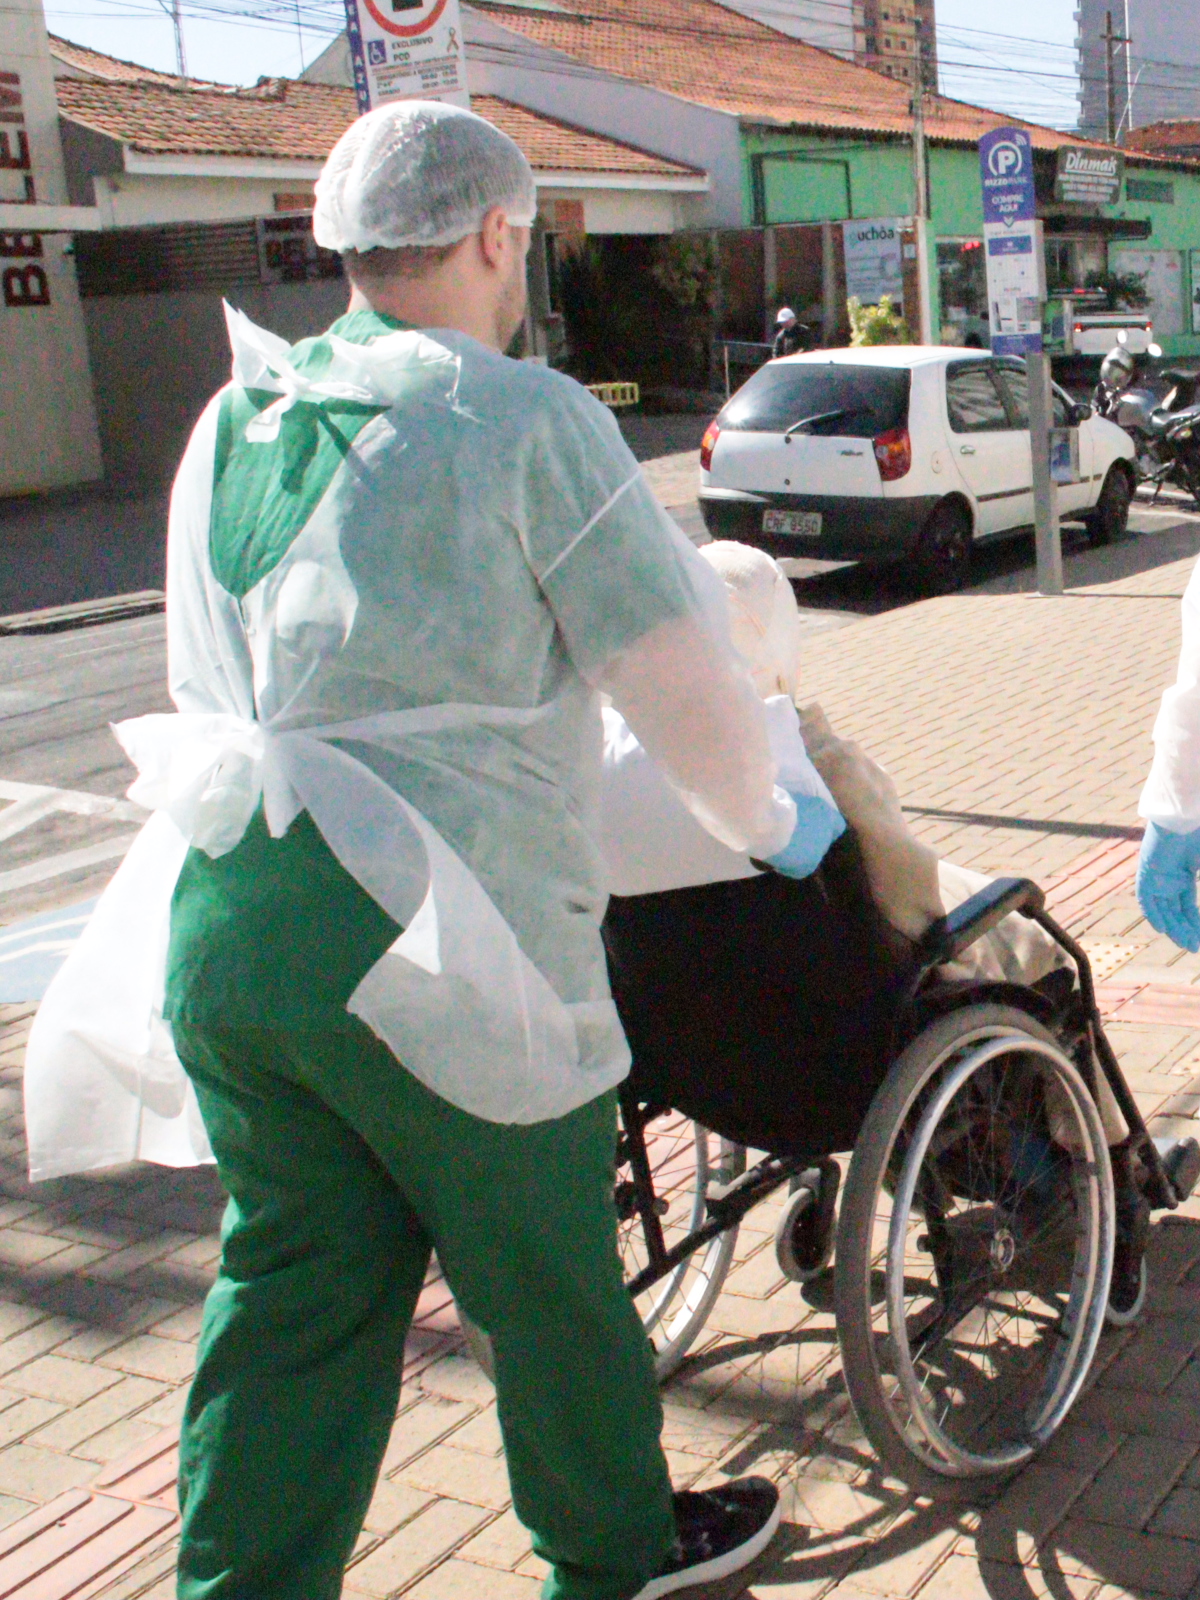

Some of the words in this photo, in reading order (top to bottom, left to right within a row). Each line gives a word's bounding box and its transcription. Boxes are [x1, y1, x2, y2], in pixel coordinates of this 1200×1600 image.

[391, 37, 433, 49] EXCLUSIVO
[393, 52, 411, 62] PCD
[354, 54, 368, 112] AZU
[998, 150, 1016, 175] P
[1065, 151, 1117, 175] Dinmais
[991, 195, 1025, 205] COMPRE
[999, 204, 1019, 213] AQUI
